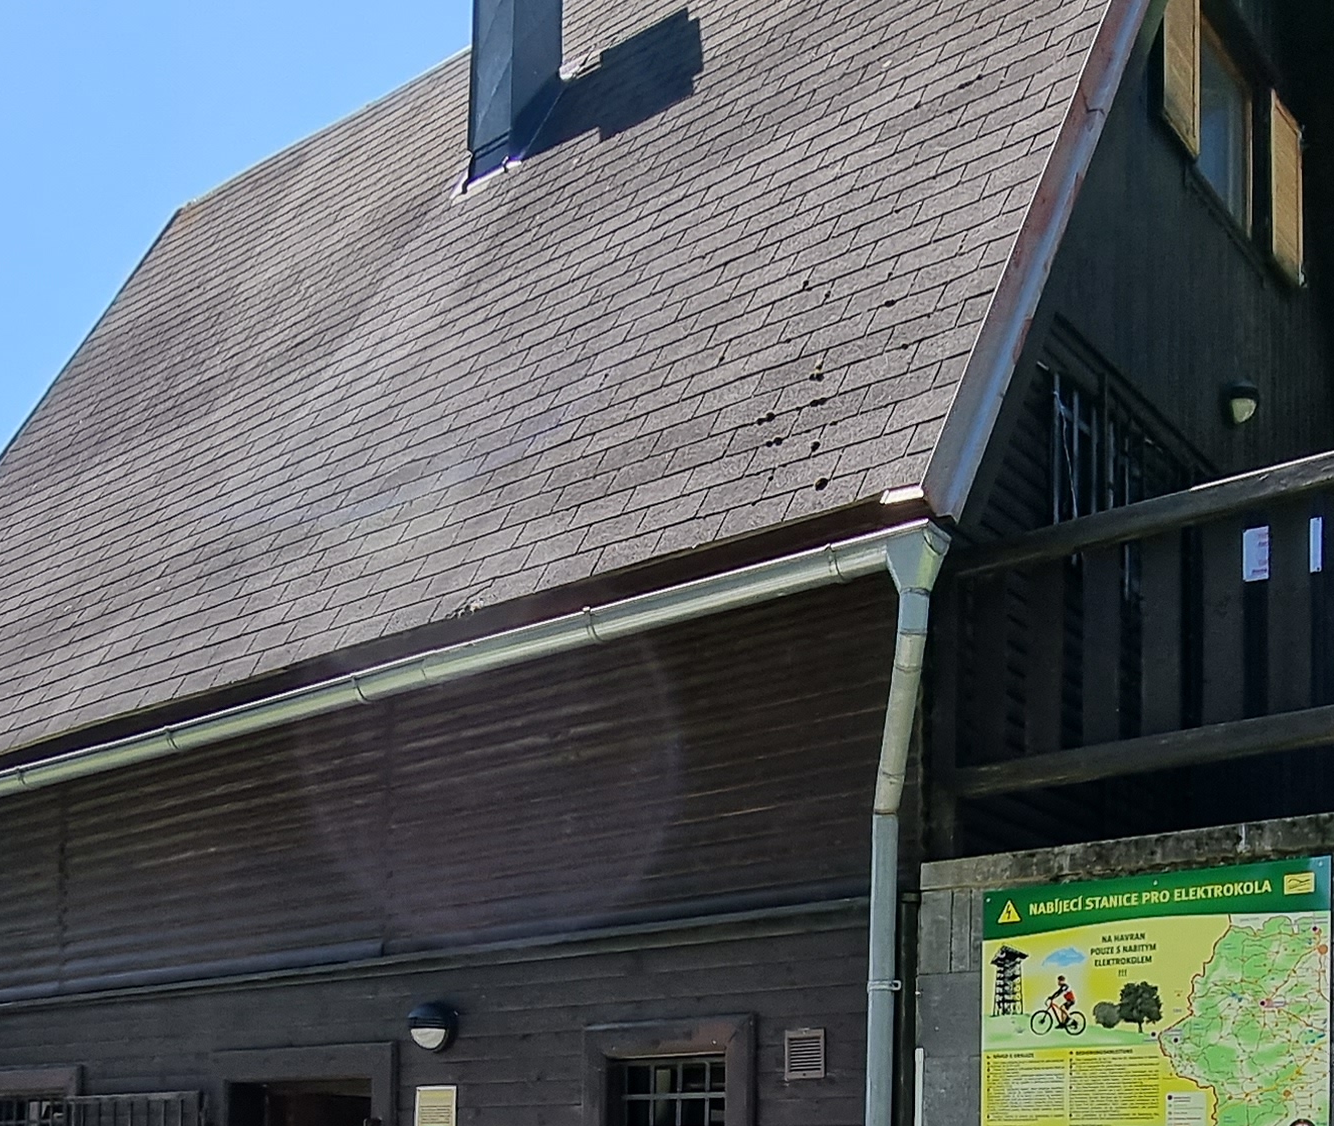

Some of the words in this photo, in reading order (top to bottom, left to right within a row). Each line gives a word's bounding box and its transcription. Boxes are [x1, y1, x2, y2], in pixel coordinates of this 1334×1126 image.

[1029, 895, 1083, 916] NABÍJECÍ
[1085, 893, 1139, 911] STANICE
[1142, 889, 1170, 905] PRO
[1174, 880, 1272, 902] ELEKTROKOLA
[1102, 935, 1112, 943] NA
[1114, 932, 1146, 942] HAVRAN
[1090, 946, 1114, 955] POUZE
[1116, 945, 1121, 954] S
[1094, 955, 1153, 967] ELEKTROKOLEM
